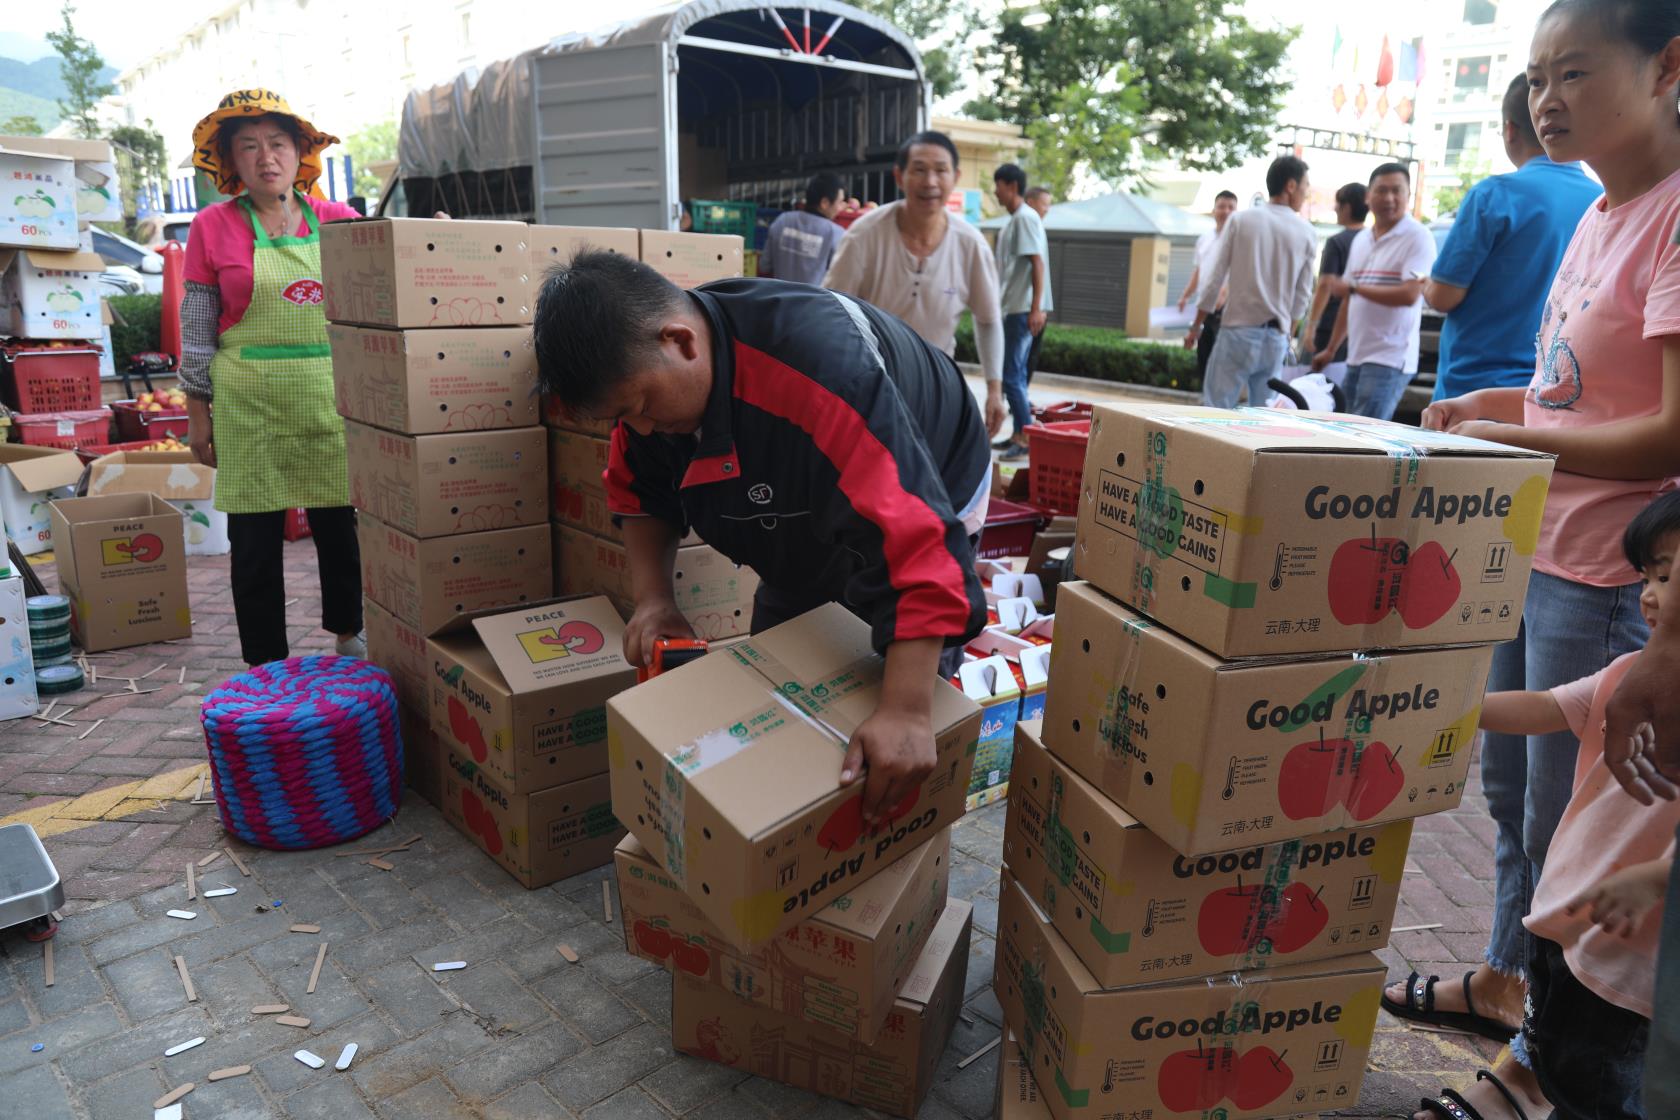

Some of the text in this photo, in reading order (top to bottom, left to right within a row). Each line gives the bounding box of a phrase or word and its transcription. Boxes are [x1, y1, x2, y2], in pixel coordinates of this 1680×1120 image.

[21, 224, 37, 236] 60
[53, 319, 67, 330] 60
[1102, 480, 1130, 503] HAVE
[1131, 492, 1139, 507] A
[1181, 511, 1219, 539] TASTE
[1305, 485, 1512, 524] Good Apple
[38, 528, 51, 542] 60
[113, 523, 144, 533] PEACE
[1100, 501, 1127, 526] HAVE
[1129, 514, 1137, 529] A
[1178, 534, 1216, 563] GAINS
[525, 610, 566, 625] PEACE
[434, 661, 492, 714] Good Apple
[1119, 685, 1150, 715] Safe
[1246, 683, 1440, 732] Good Apple
[537, 723, 564, 738] HAVE
[537, 735, 564, 750] HAVE
[449, 753, 509, 810] Good Apple
[551, 819, 577, 833] HAVE
[552, 830, 577, 845] HAVE
[783, 807, 938, 913] Good Apple
[1022, 799, 1041, 824] HAVE
[1075, 852, 1101, 890] TASTE
[1020, 815, 1040, 842] HAVE
[1072, 875, 1099, 910] GAINS
[1172, 846, 1265, 879] Good
[1131, 1000, 1342, 1041] Good Apple
